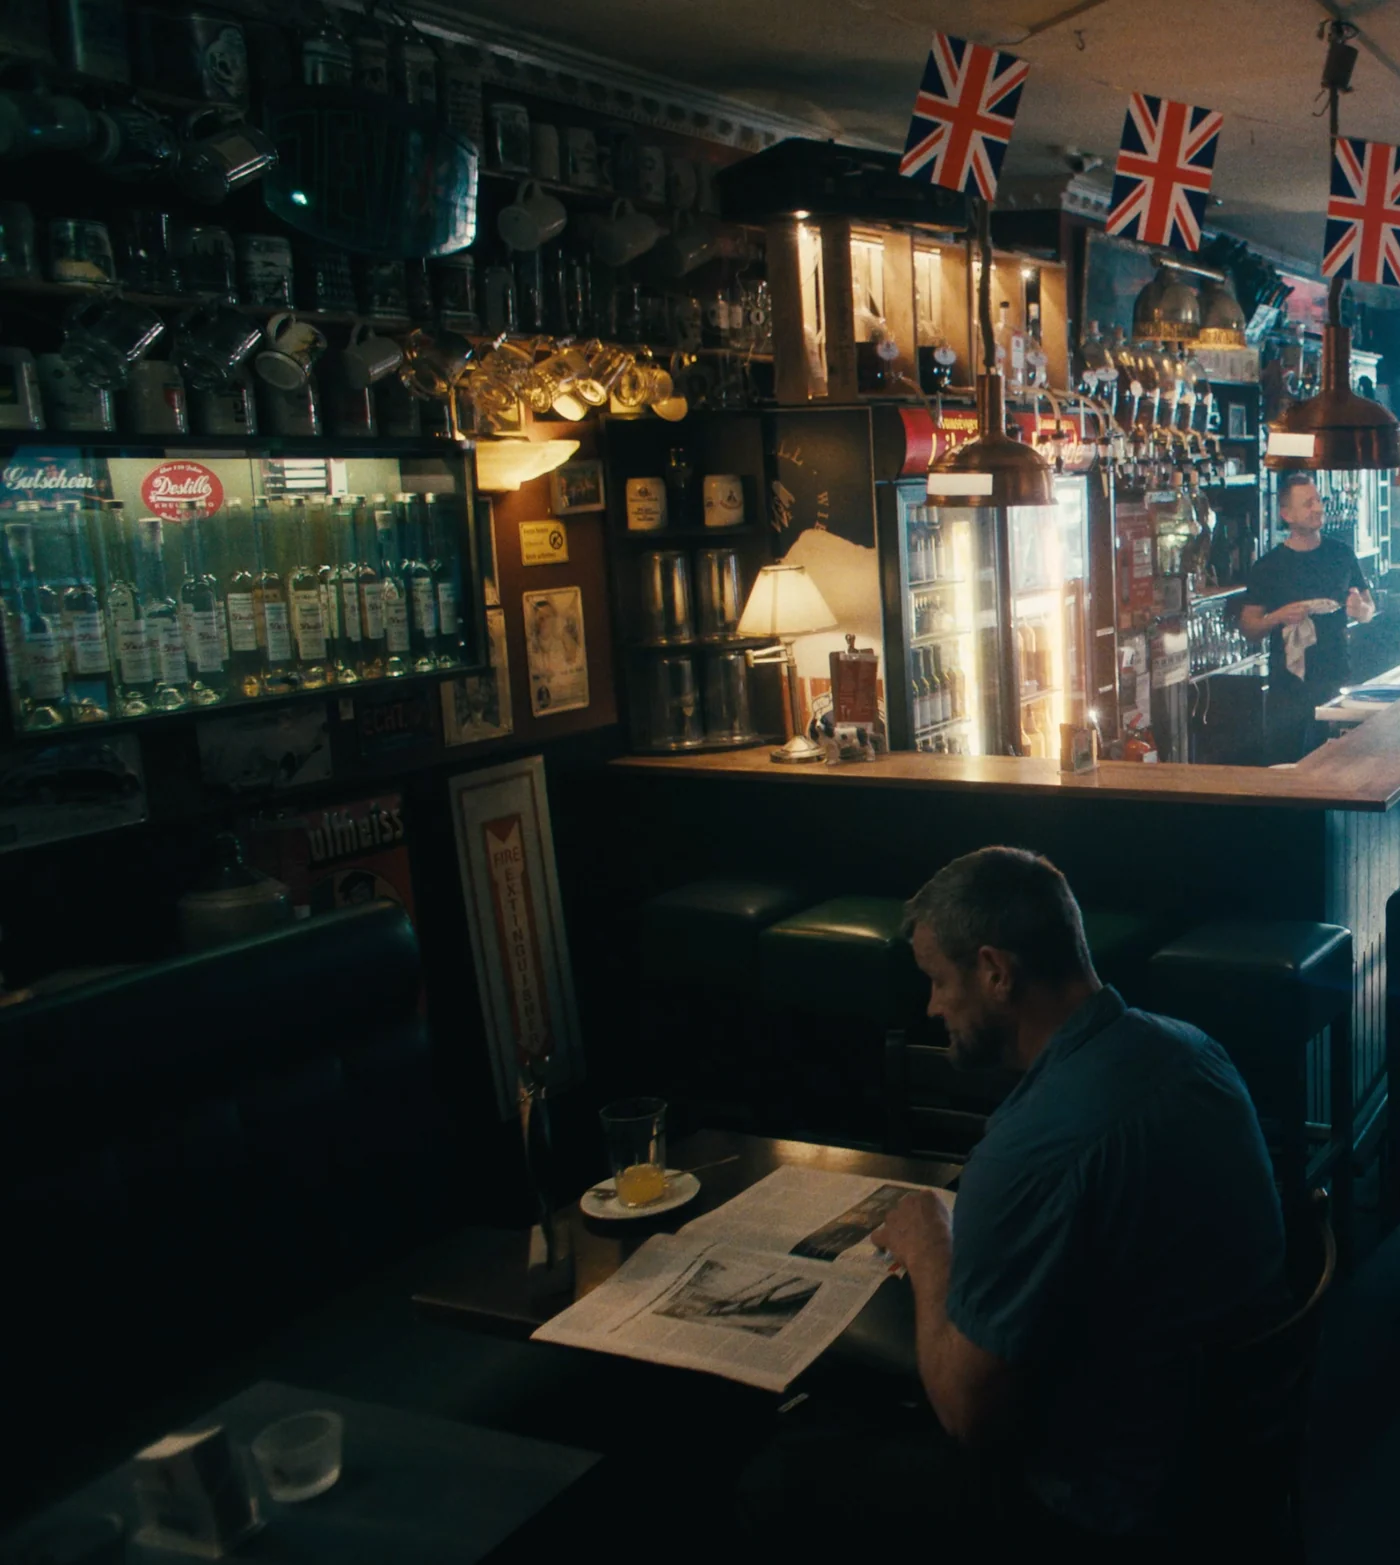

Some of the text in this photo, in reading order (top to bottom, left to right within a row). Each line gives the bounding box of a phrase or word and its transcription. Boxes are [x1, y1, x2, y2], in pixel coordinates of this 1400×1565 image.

[3, 467, 96, 489] Gutschein
[150, 475, 212, 498] Destille
[307, 801, 404, 862] ultheiss
[493, 845, 521, 868] FIRE
[505, 868, 540, 1046] EXTINGUISHER
